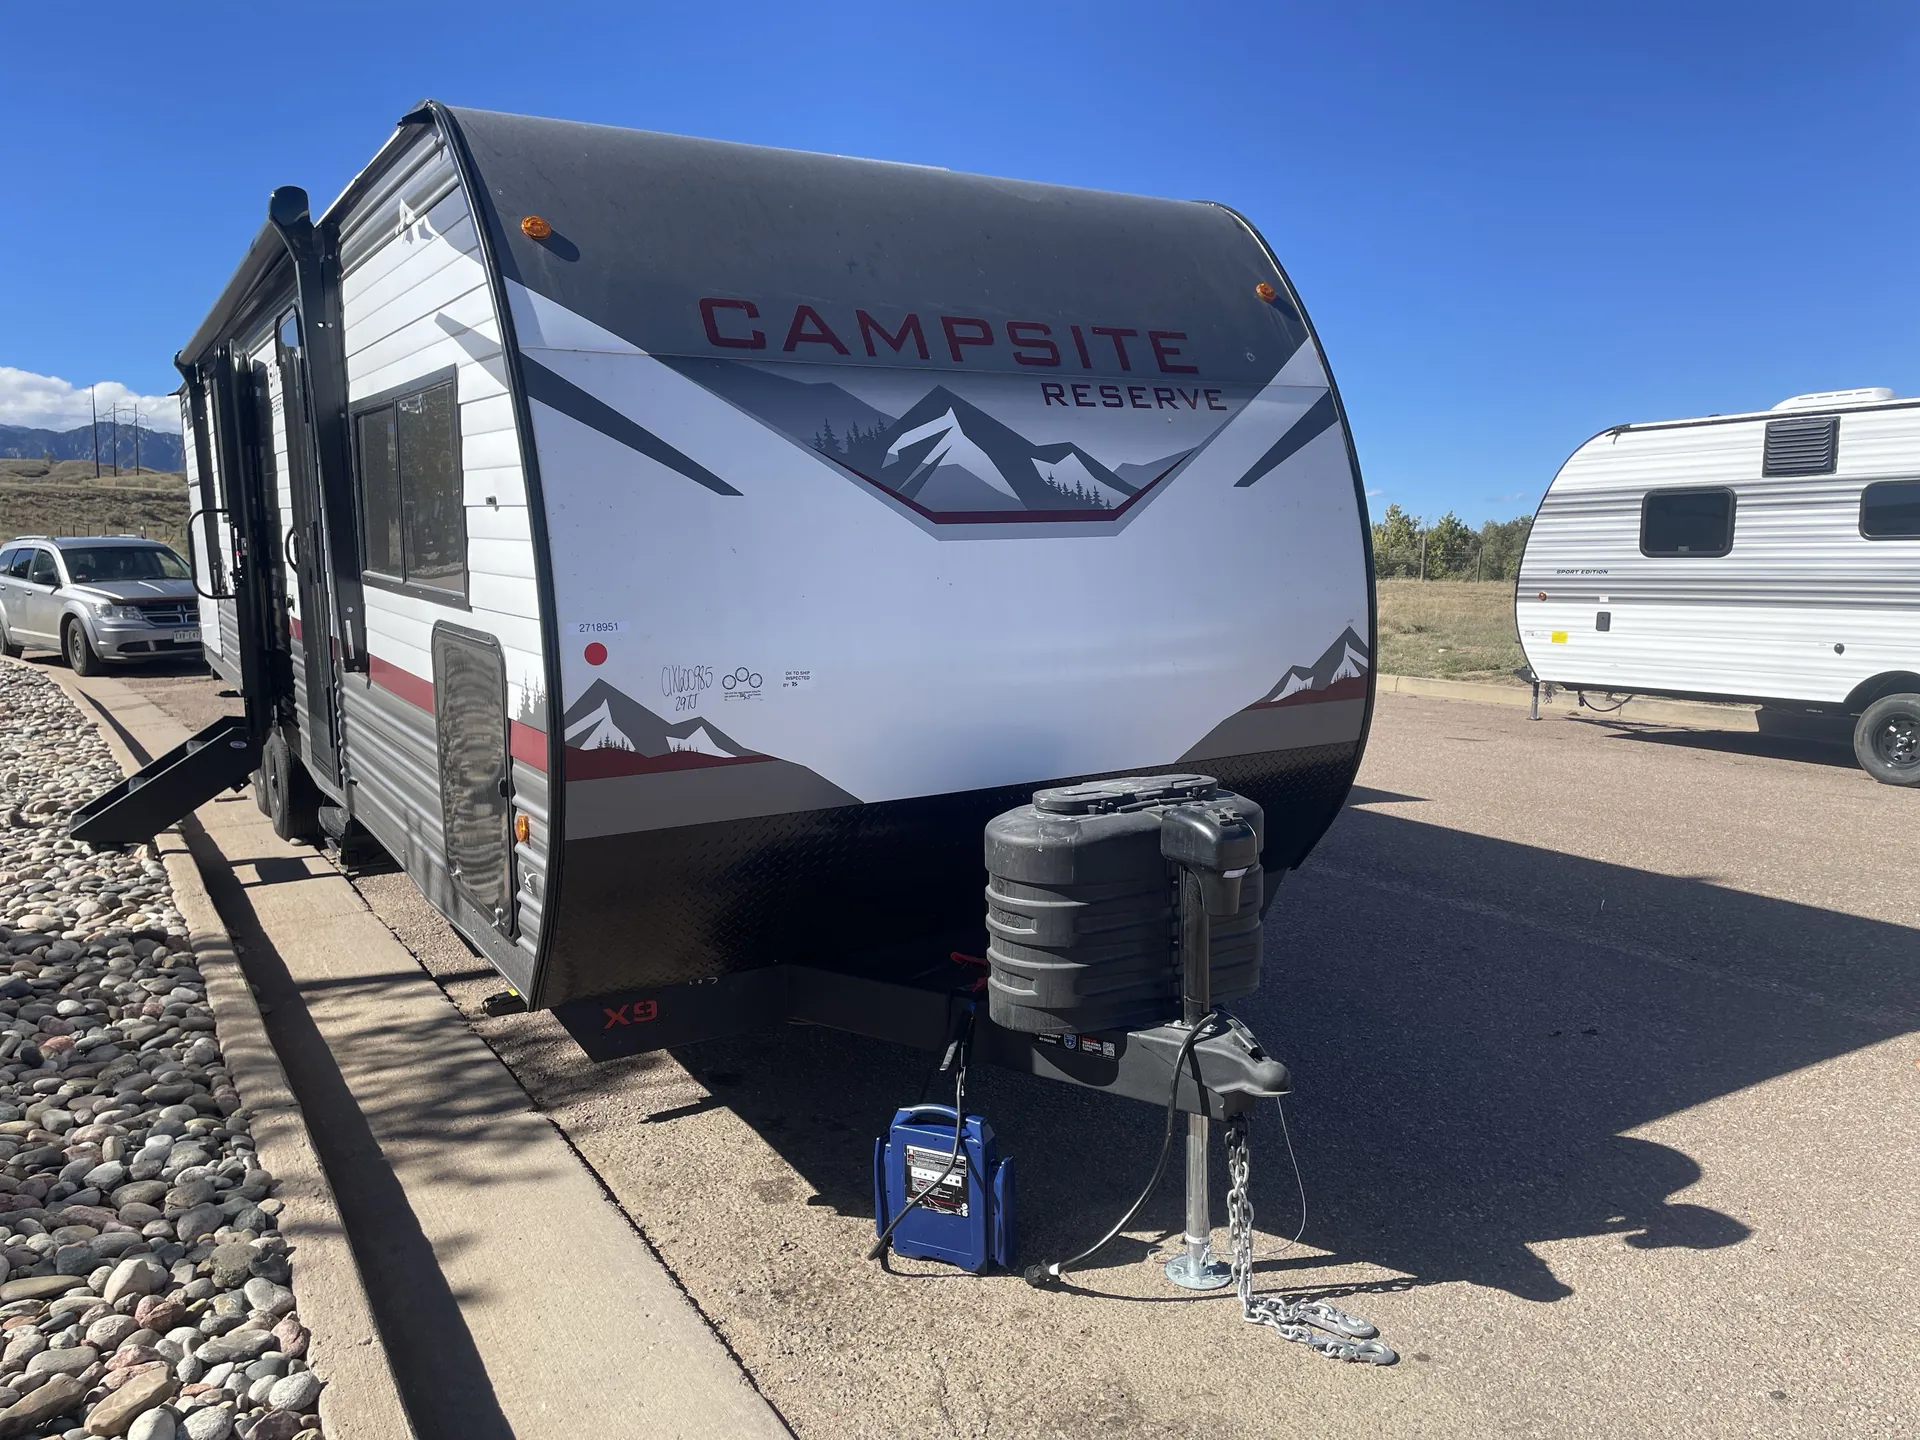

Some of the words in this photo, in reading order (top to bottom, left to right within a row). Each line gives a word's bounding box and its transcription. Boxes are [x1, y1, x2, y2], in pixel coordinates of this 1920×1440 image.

[699, 297, 1199, 374] CAMPSITE
[1041, 382, 1228, 411] RESERVE
[579, 622, 619, 633] 2718951
[603, 1000, 658, 1030] X9
